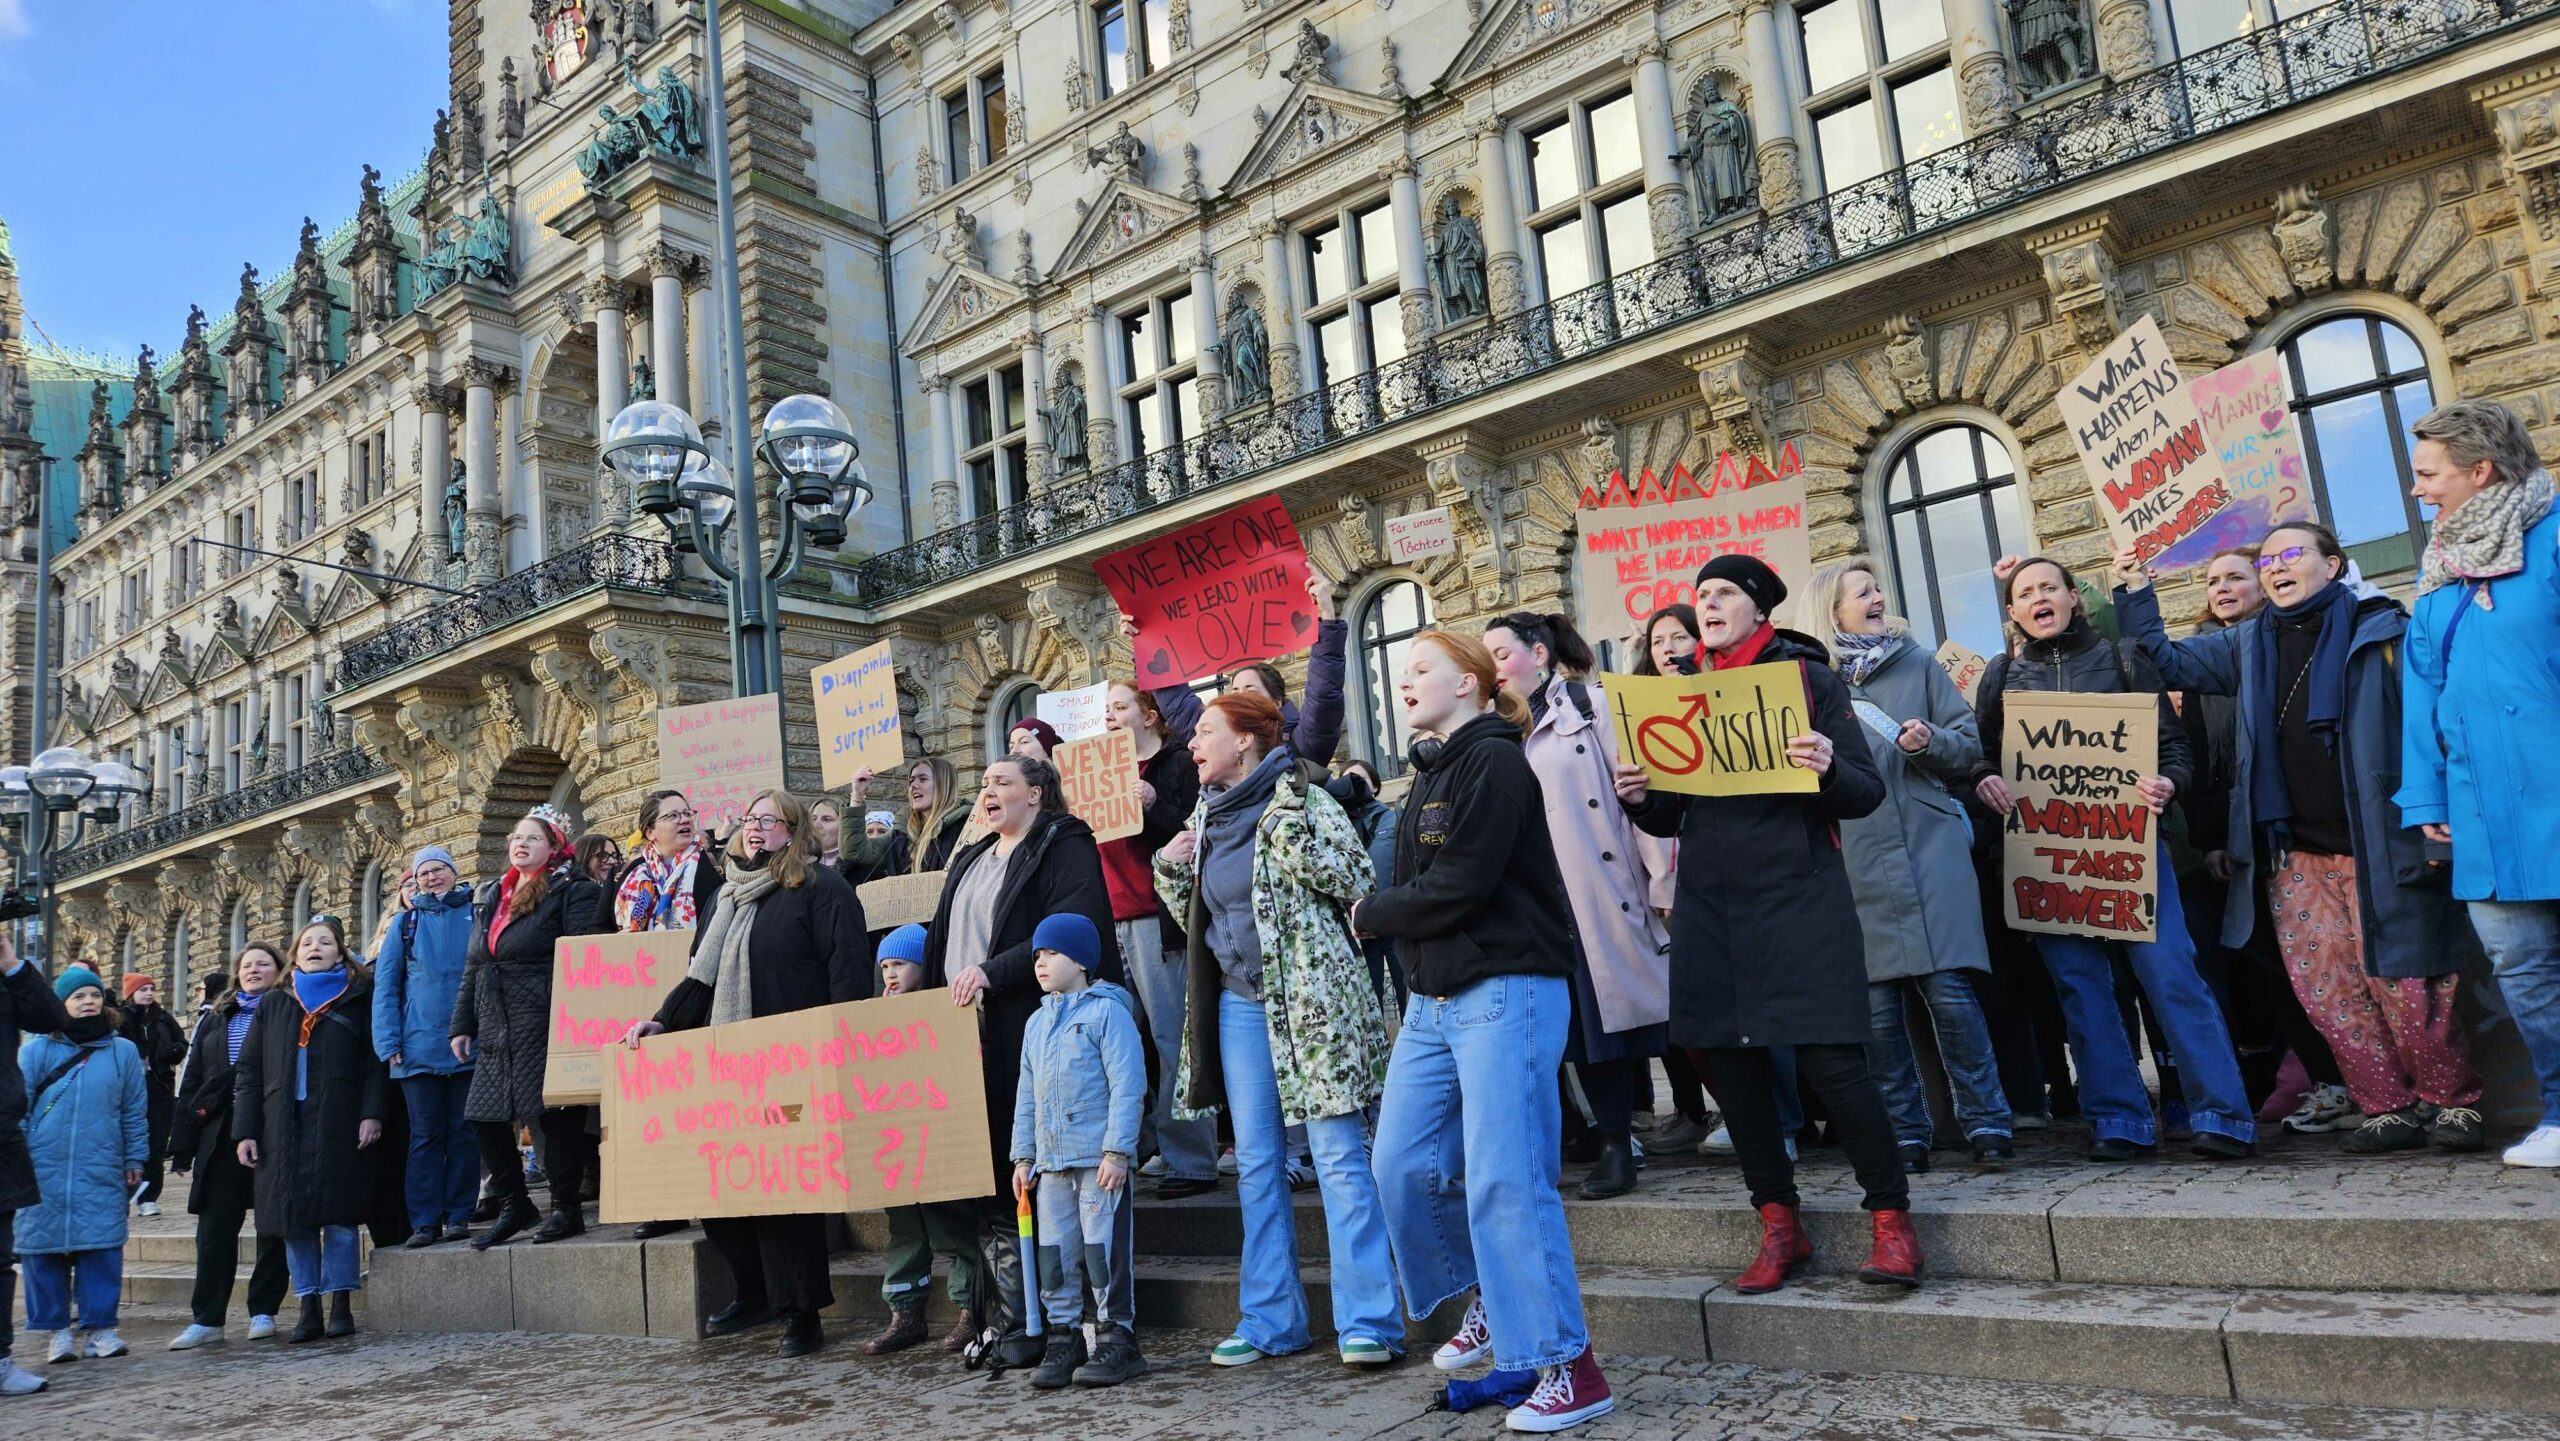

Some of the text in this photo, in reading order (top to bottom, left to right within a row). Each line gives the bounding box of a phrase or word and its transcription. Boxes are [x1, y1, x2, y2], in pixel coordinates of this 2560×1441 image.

[2076, 336, 2146, 405] What
[2078, 358, 2179, 452] HAPPENS
[2101, 409, 2170, 472] when A
[2220, 435, 2260, 463] WIR
[2101, 418, 2207, 514] WOMAN
[1388, 516, 1446, 536] Für unsere
[1585, 502, 1802, 554] WHAT HAPPENS WHEN
[2120, 483, 2184, 534] TAKES
[1109, 506, 1299, 595] WE ARE ONE
[1393, 535, 1448, 557] Töchter
[1616, 553, 1650, 581] WE
[1716, 537, 1767, 561] THE
[1161, 563, 1289, 622] WE LEAD WITH
[1165, 599, 1287, 678] LOVE
[821, 650, 892, 696] Disappointed
[667, 708, 713, 736] What
[844, 692, 885, 718] but not
[1057, 694, 1095, 708] SMASH
[1068, 711, 1086, 721] THE
[833, 706, 899, 754] surprised
[2018, 718, 2130, 753] What
[1055, 734, 1131, 777] WE'VE
[2015, 750, 2140, 790] happens
[1063, 764, 1133, 807] JUST
[2050, 781, 2120, 801] when
[2006, 796, 2149, 844] A WOMAN
[2034, 846, 2147, 883] TAKES
[2012, 876, 2155, 932] POWER!
[560, 944, 656, 991] What
[617, 1045, 694, 1103] What
[813, 1016, 938, 1068] when
[643, 1074, 949, 1144] a woman takes
[698, 1131, 850, 1200] POWER
